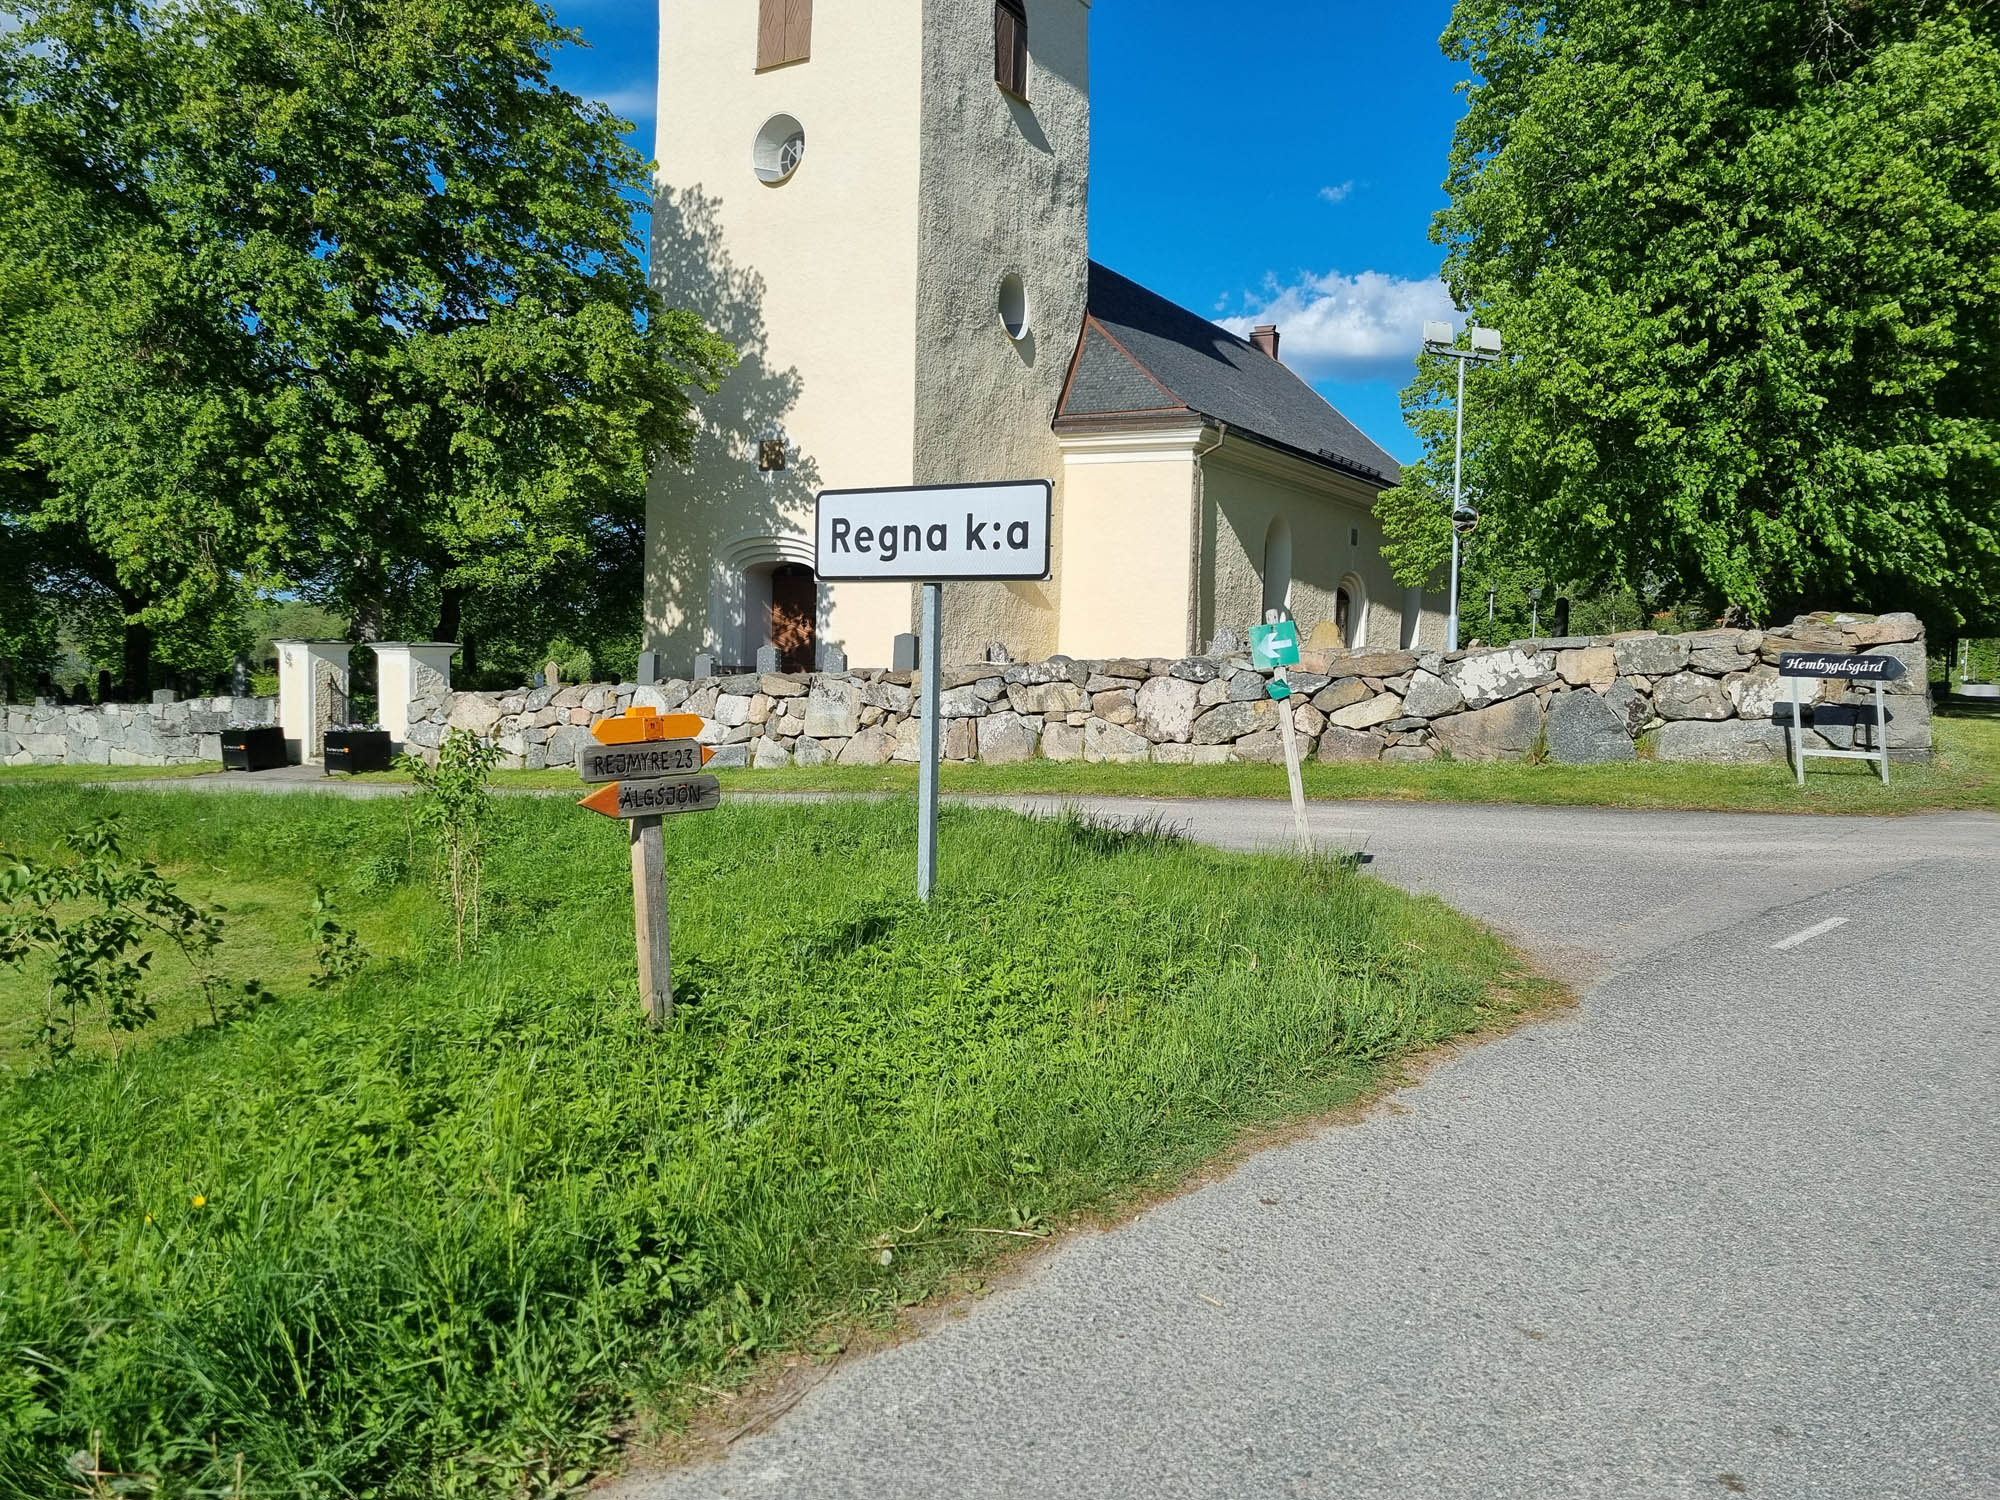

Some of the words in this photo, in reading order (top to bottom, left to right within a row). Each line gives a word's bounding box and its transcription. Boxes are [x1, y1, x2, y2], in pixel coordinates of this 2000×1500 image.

[832, 517, 947, 562] Regna
[966, 513, 1029, 550] k:a
[1785, 657, 1886, 675] Hembygdsgård
[594, 750, 670, 777] REJMYRE
[675, 748, 694, 768] 23
[621, 782, 701, 808] ÄLGSJÖN
